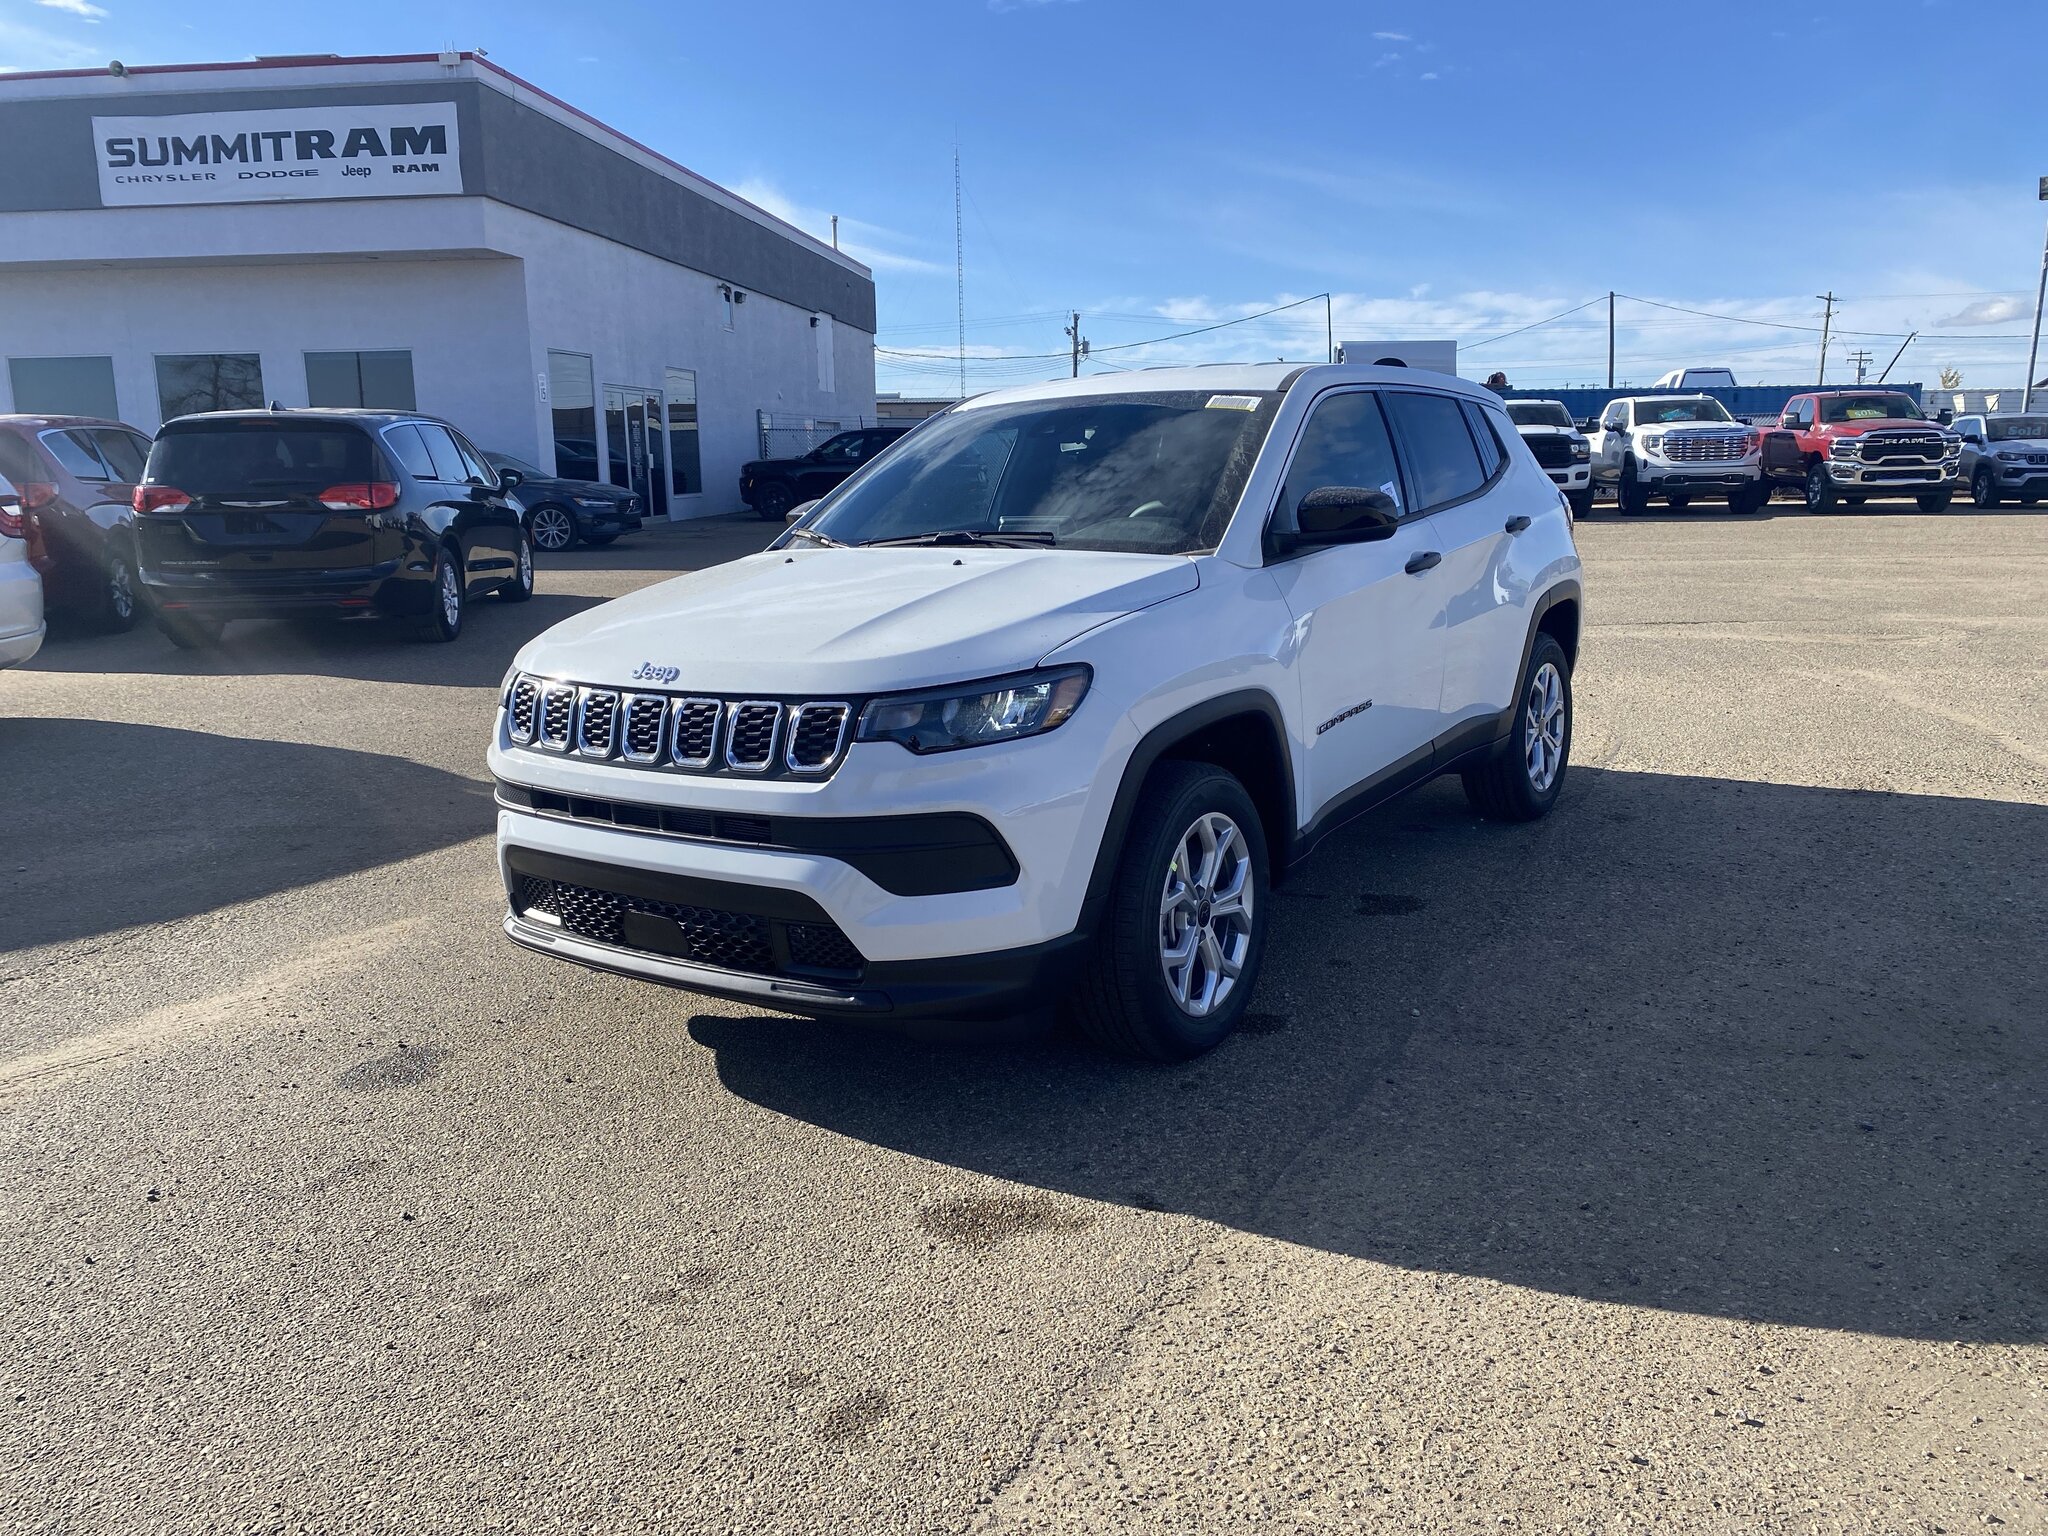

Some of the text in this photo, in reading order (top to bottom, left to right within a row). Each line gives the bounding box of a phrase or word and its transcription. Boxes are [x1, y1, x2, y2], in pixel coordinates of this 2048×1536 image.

[115, 163, 440, 184] CHRYSLER DODGE Jeep RAM
[2007, 426, 2042, 436] Sold
[631, 661, 681, 685] Jeep
[1316, 698, 1373, 735] COMPASS
